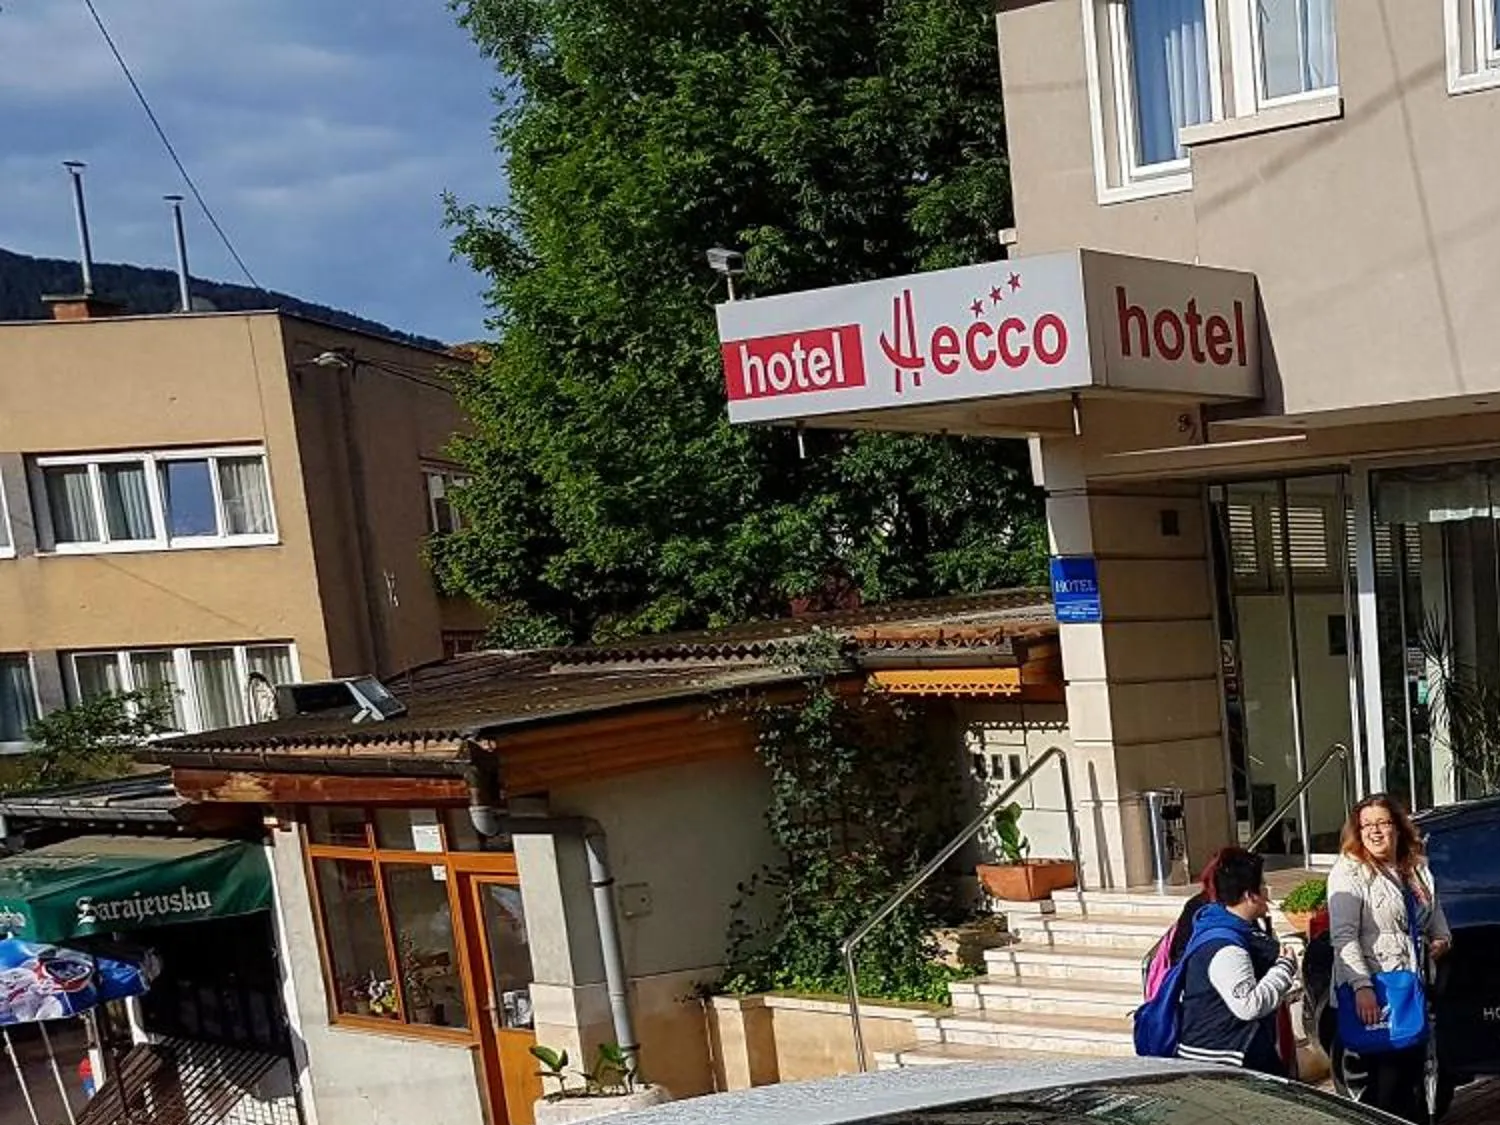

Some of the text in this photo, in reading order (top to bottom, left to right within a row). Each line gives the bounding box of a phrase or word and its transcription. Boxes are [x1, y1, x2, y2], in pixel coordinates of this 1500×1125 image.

[740, 289, 1068, 395] hotel Hecco
[1116, 285, 1247, 367] hotel
[1055, 579, 1097, 593] HOTEL
[77, 886, 212, 924] Sarajevsko
